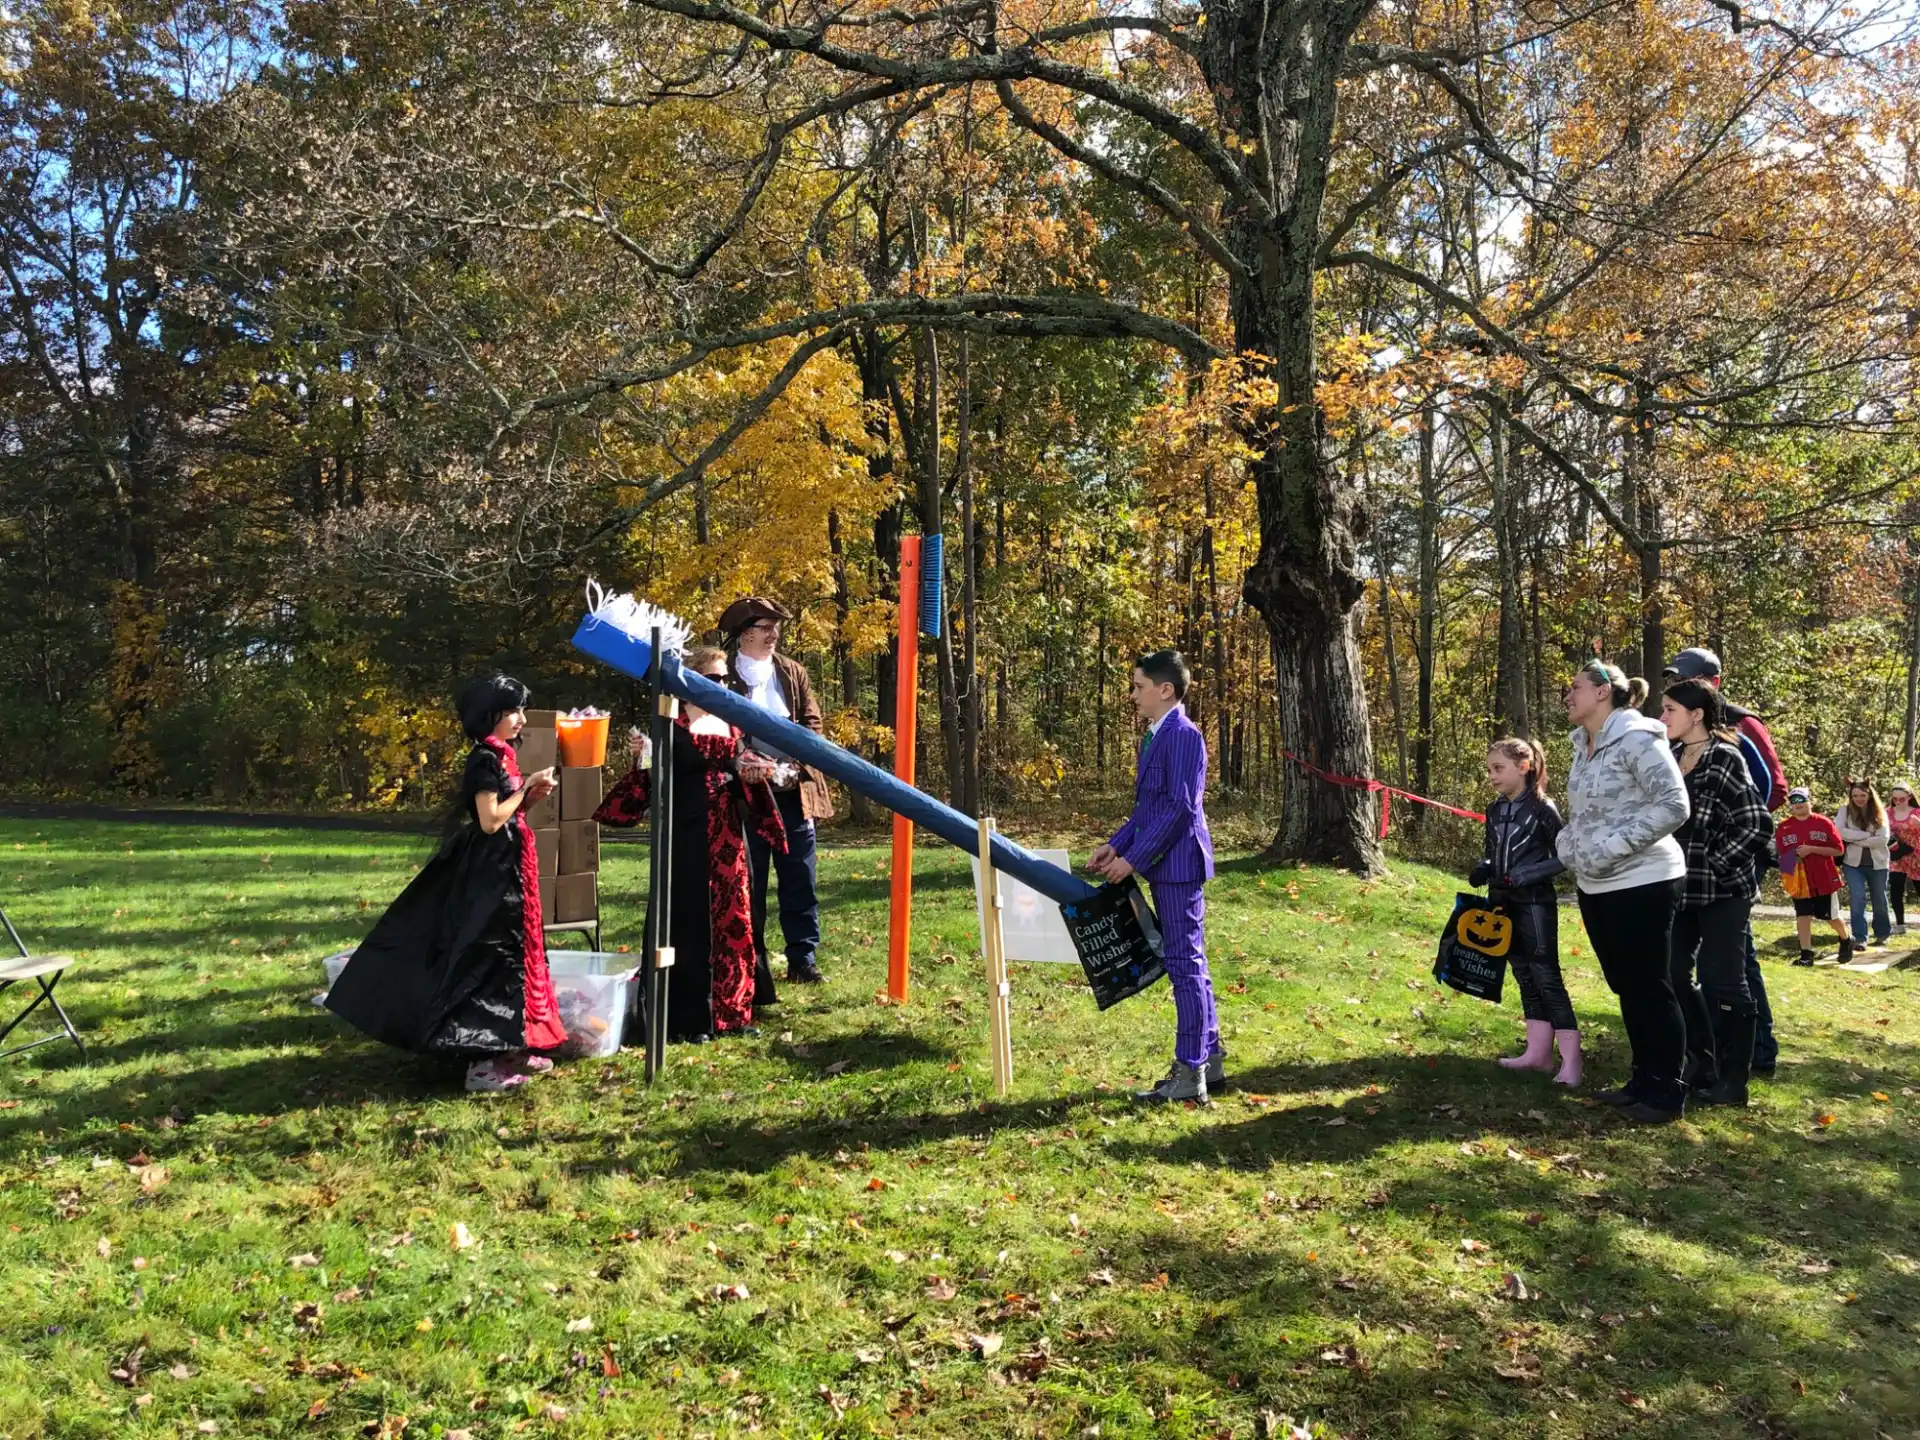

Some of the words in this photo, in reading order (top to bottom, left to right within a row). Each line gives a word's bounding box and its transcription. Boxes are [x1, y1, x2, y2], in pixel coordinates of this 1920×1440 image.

[1075, 913, 1119, 938] Candy-
[1080, 928, 1119, 953] Filled
[1087, 939, 1132, 968] Wishes
[1478, 956, 1489, 964] for
[1459, 958, 1497, 979] Wishes
